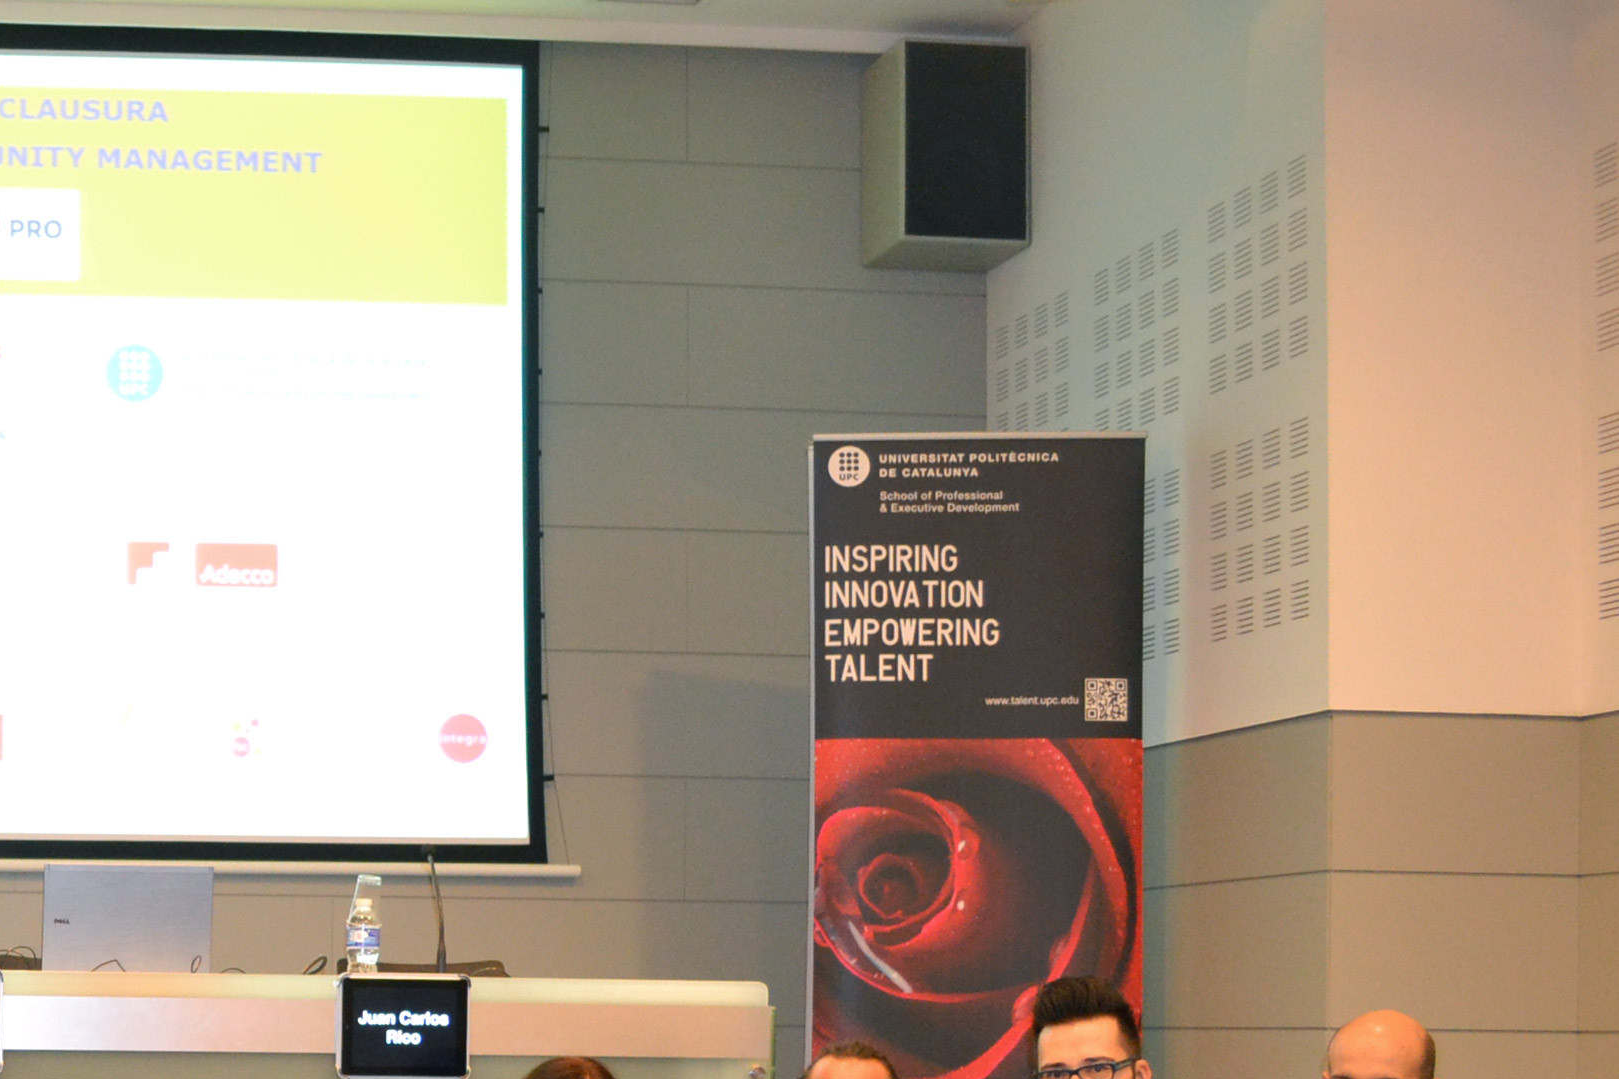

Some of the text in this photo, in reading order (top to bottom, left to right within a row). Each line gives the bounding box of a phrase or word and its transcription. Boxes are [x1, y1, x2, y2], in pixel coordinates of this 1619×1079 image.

[97, 147, 323, 174] MANAGEMENT
[9, 219, 63, 239] PRO
[879, 451, 1060, 464] UNIVERSITAT POLITÈCNICA
[838, 473, 860, 482] UPC
[879, 467, 980, 478] DE CATALUNYA
[879, 490, 1004, 501] School of Professional
[879, 503, 1020, 515] & Executive Development
[824, 544, 959, 573] INSPIRING
[199, 563, 275, 586] Adecco
[824, 580, 985, 609] INNOVATION
[824, 618, 1001, 647] EMPOWERING
[824, 654, 935, 682] TALENT
[984, 696, 1080, 706] www.talent.upc.edu
[357, 1009, 451, 1027] Juan Carlos
[385, 1029, 422, 1045] Rico
